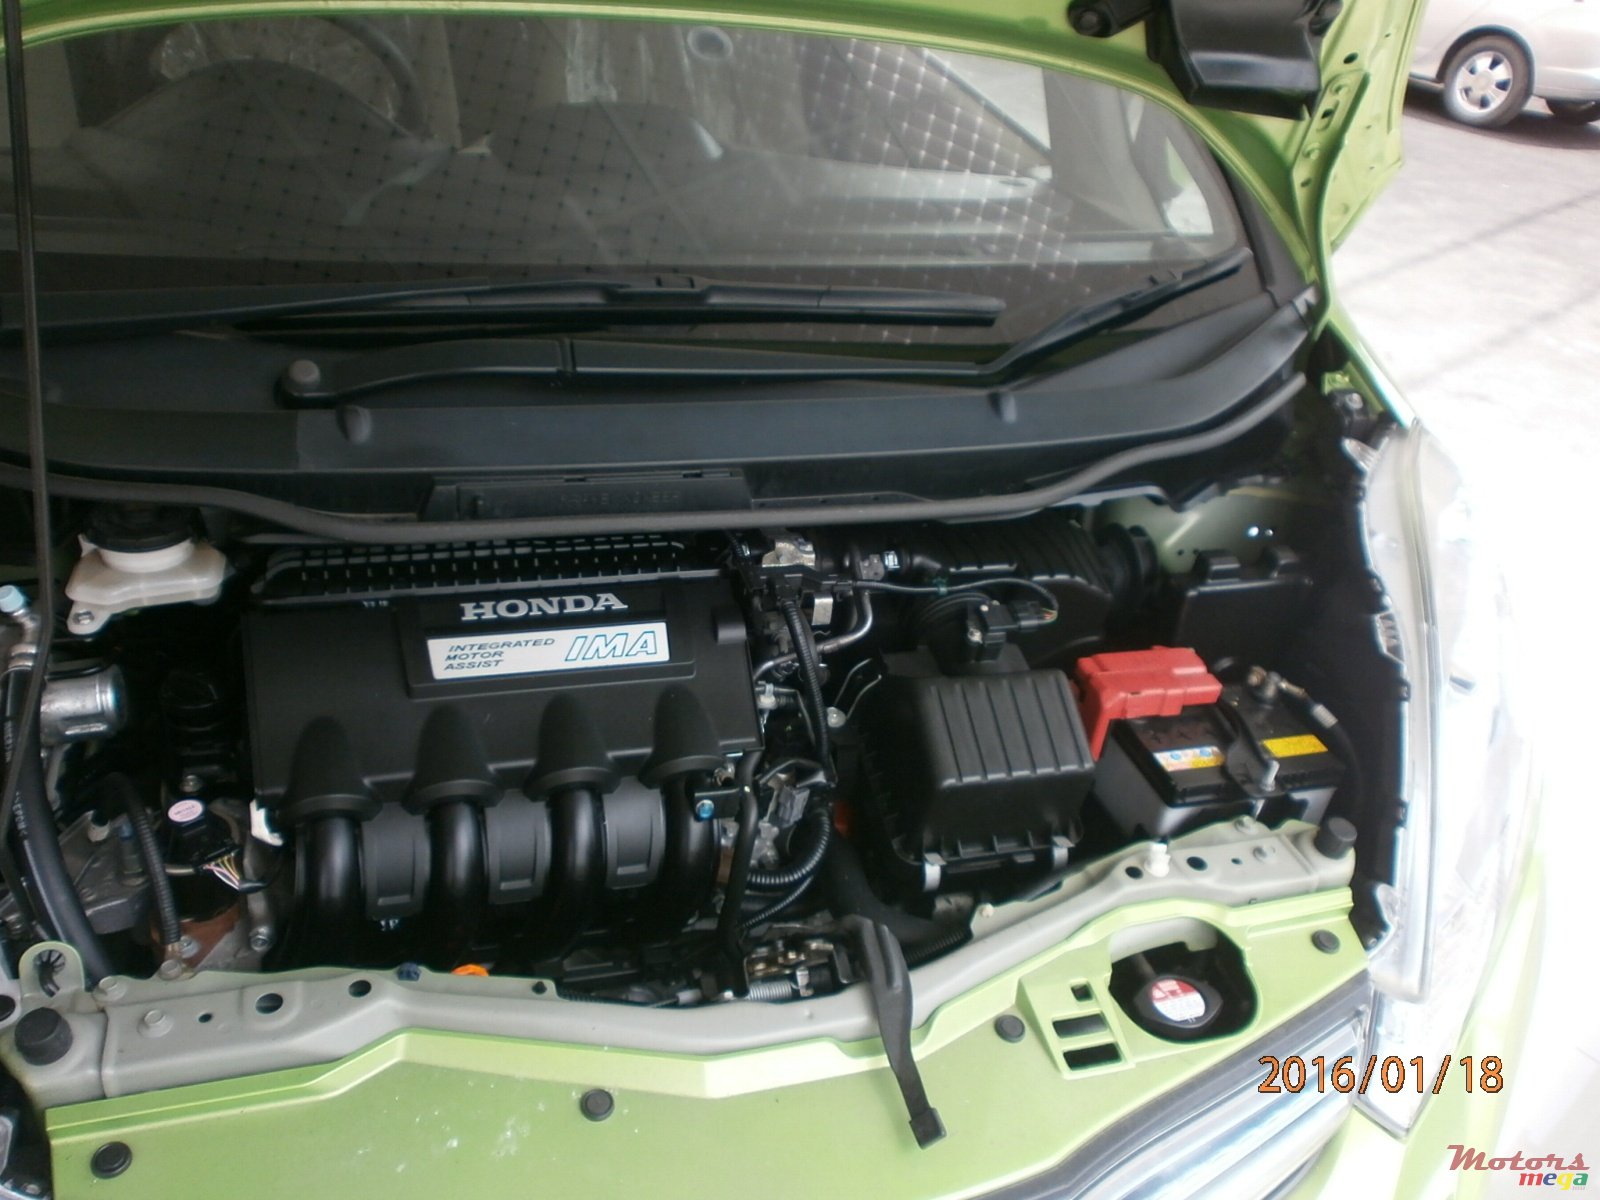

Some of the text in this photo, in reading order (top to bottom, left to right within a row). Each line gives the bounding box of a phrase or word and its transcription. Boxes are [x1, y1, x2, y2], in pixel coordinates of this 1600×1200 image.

[460, 593, 628, 621] HONDA
[448, 638, 556, 653] INTEGRATED
[564, 630, 658, 662] IMA
[444, 650, 504, 662] MOTOR
[443, 660, 504, 671] ASSIST
